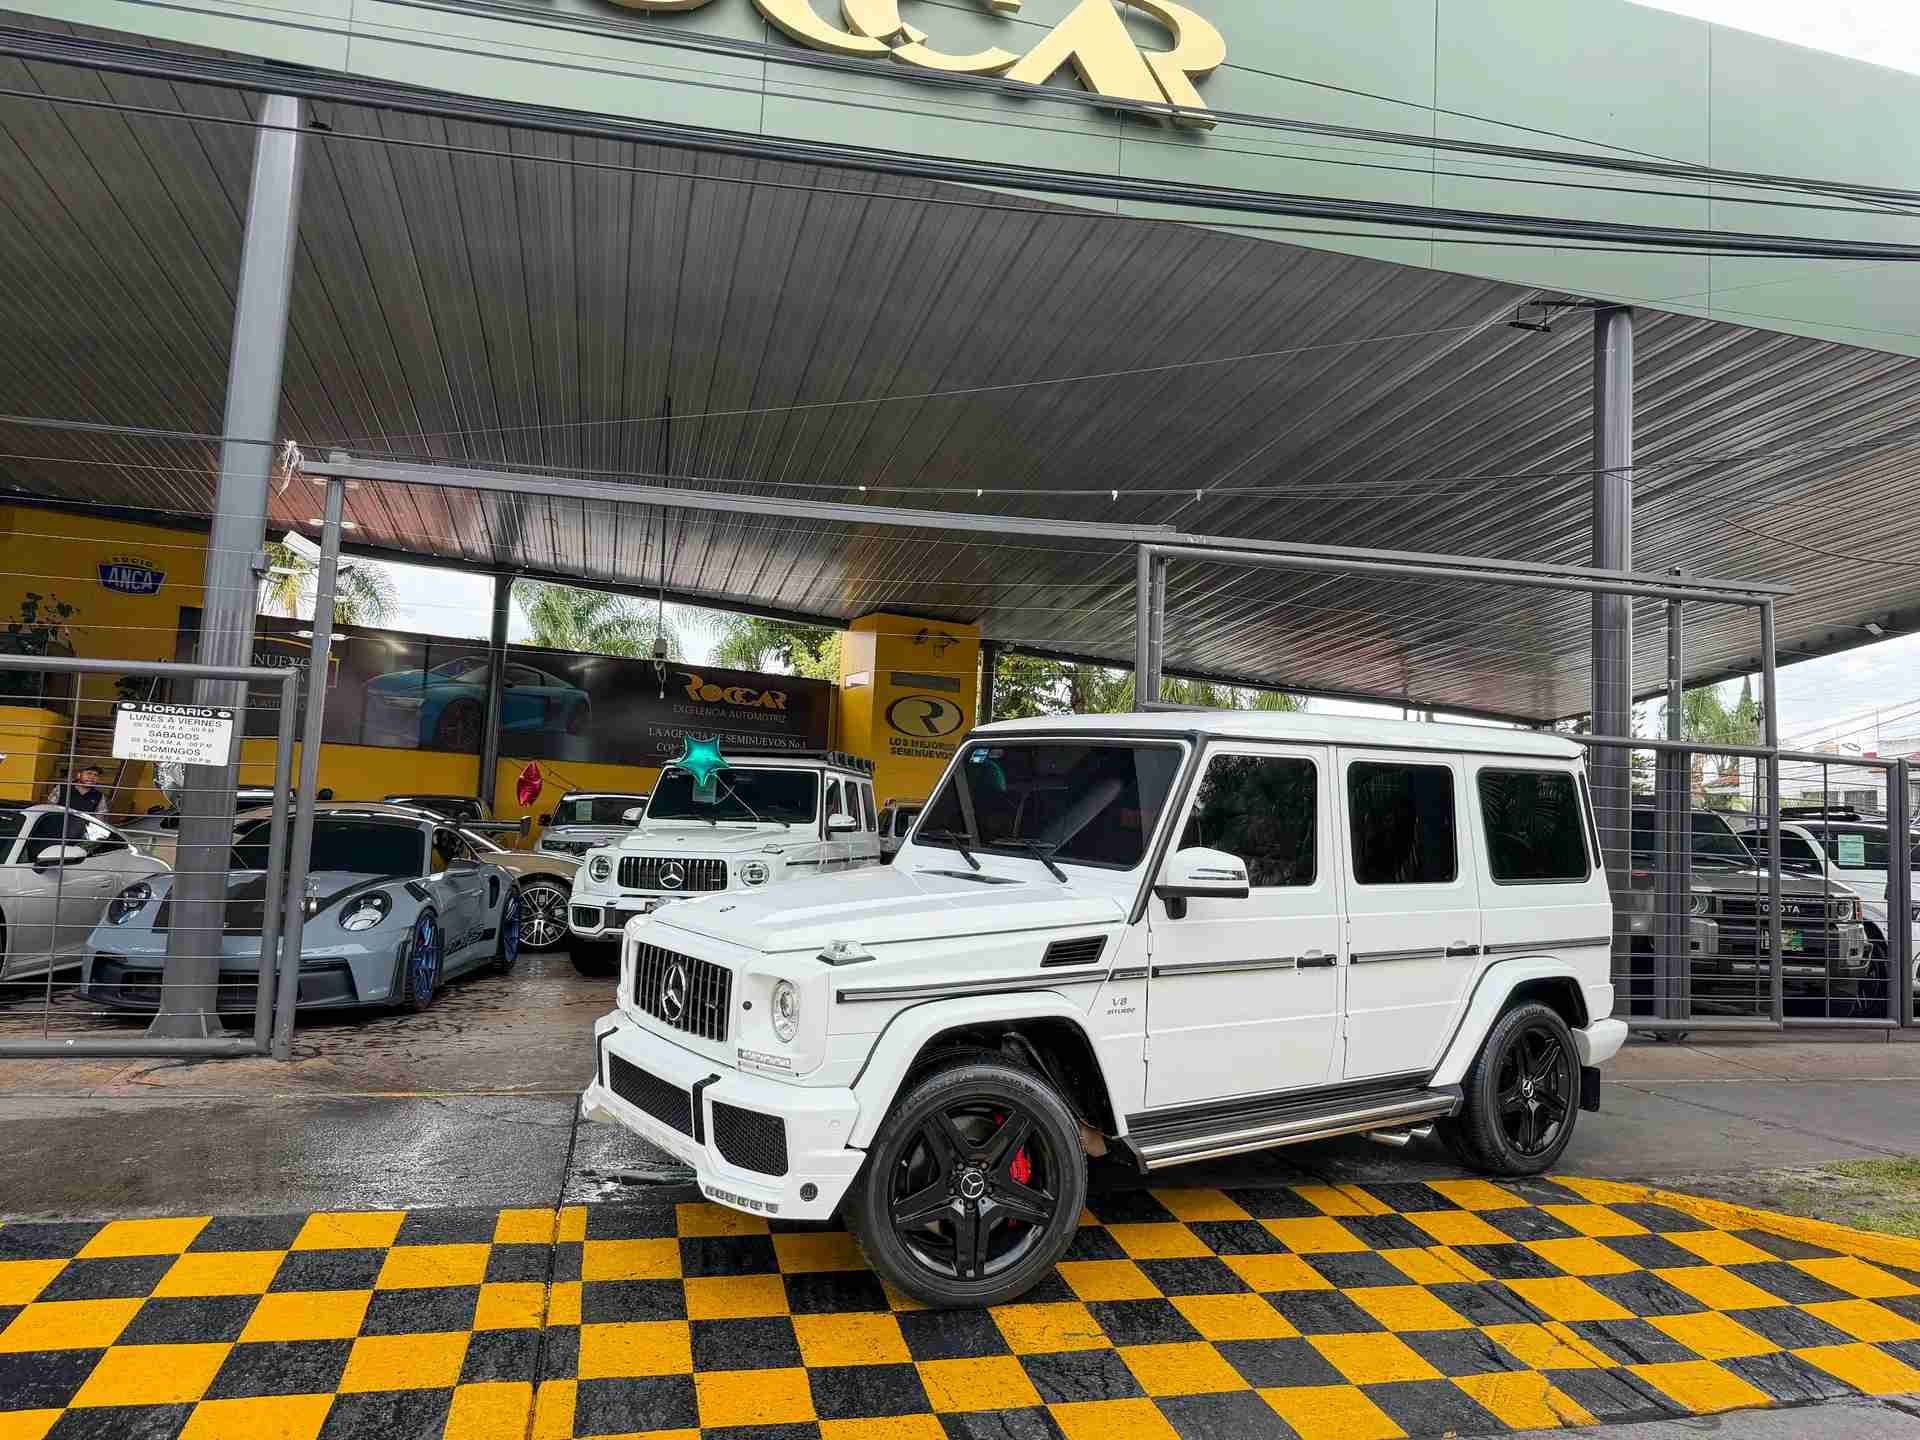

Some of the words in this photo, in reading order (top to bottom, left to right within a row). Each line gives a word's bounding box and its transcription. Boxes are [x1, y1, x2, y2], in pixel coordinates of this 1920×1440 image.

[676, 671, 787, 711] ROCCAR
[141, 703, 213, 718] HORARIO
[129, 713, 164, 724] LUNES
[178, 717, 223, 728] VIERNES
[726, 734, 787, 748] SEMINUEVOS
[143, 744, 201, 757] DOMINGOS
[1755, 903, 1800, 913] OOTA
[1112, 997, 1128, 1007] V8
